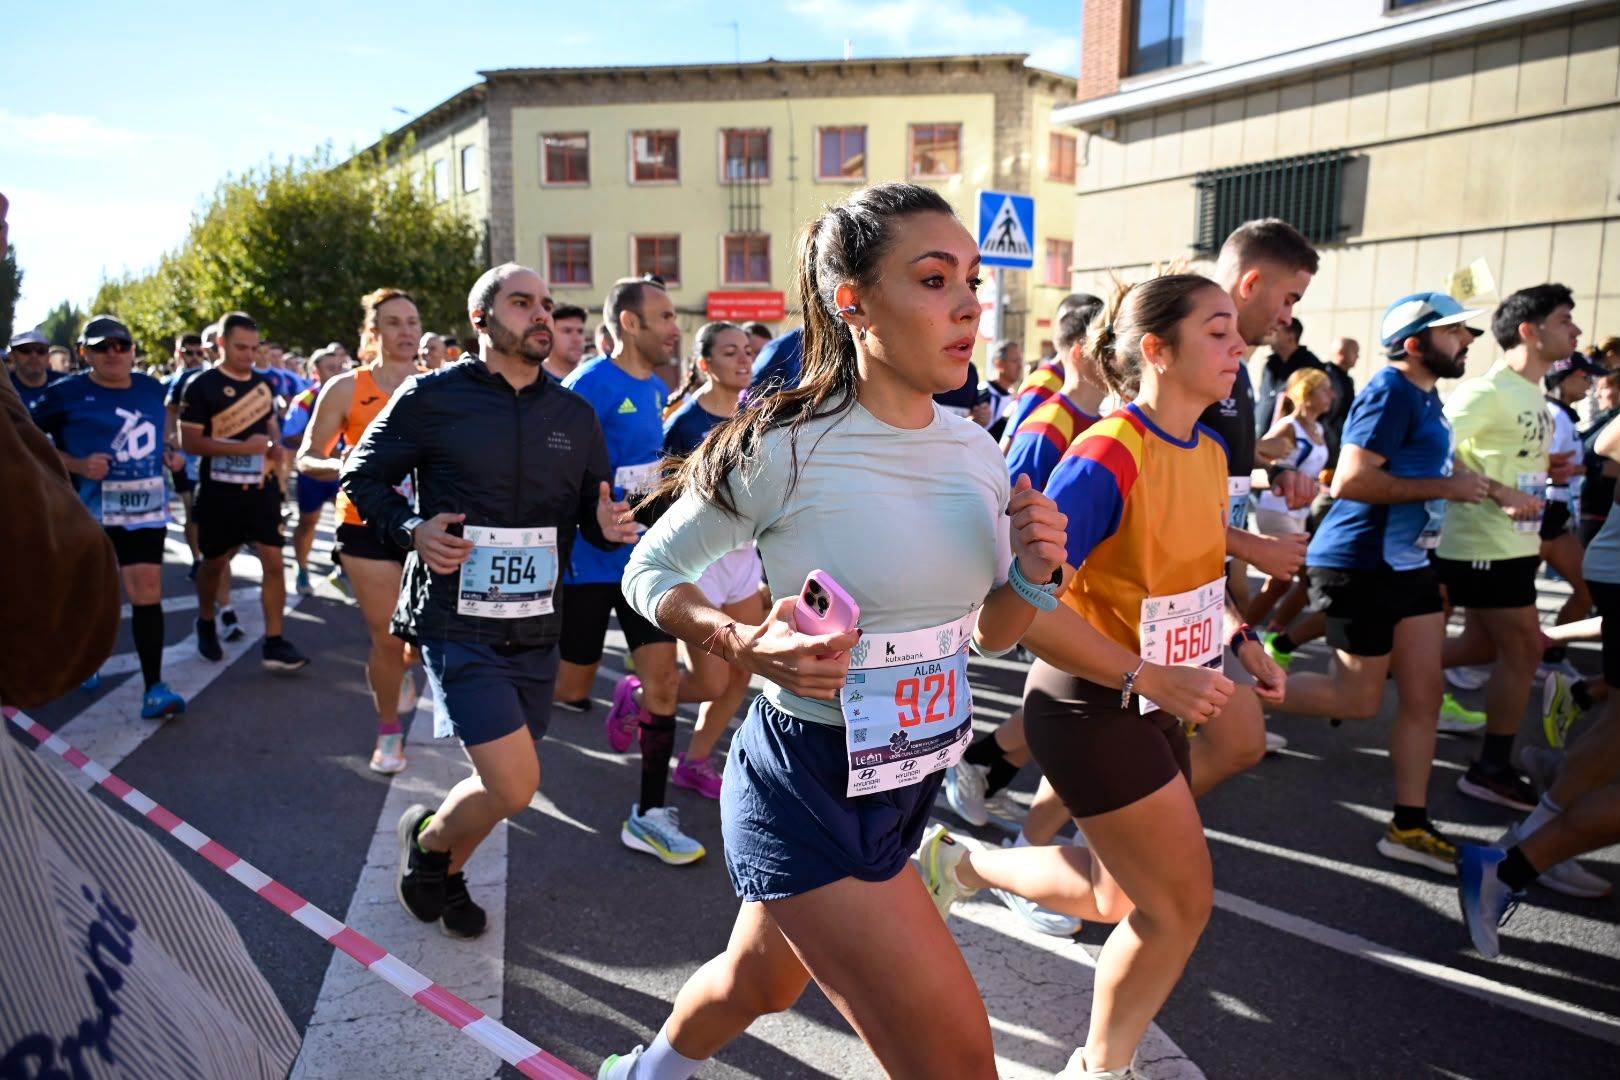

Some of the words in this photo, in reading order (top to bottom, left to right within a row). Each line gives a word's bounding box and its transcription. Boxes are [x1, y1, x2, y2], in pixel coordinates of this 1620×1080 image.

[490, 556, 536, 585] 564
[1166, 617, 1212, 665] 1560
[885, 652, 924, 663] kutxabank
[914, 663, 942, 677] ALBA
[895, 669, 956, 728] 921
